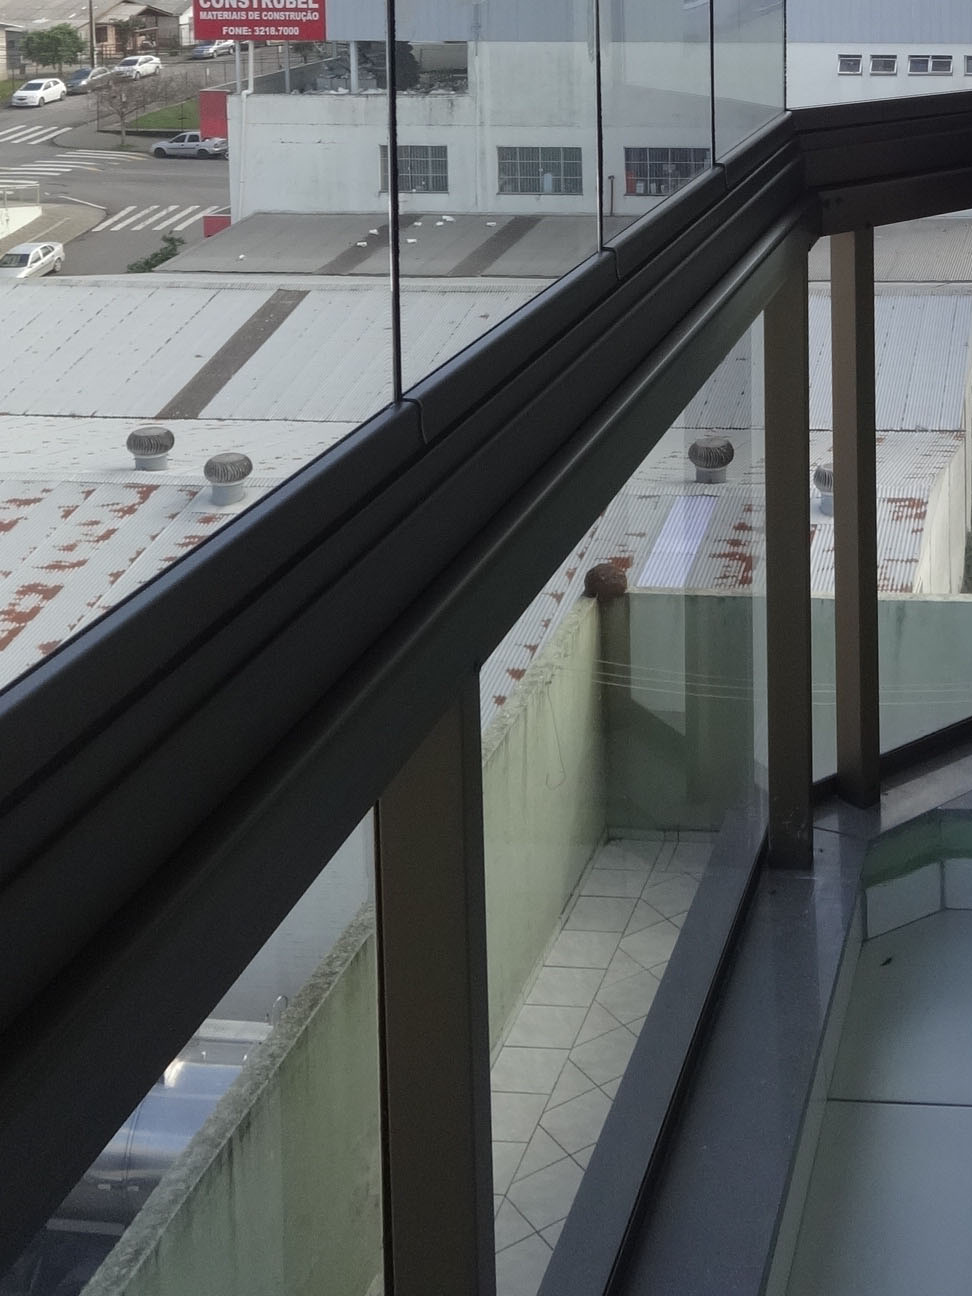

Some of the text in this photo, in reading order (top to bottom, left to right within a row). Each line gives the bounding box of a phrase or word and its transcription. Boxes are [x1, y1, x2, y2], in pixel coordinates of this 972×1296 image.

[199, 10, 319, 22] MATERIAIS DE CONSTRUÇÃO
[222, 26, 299, 35] FONE: 3218.7000
